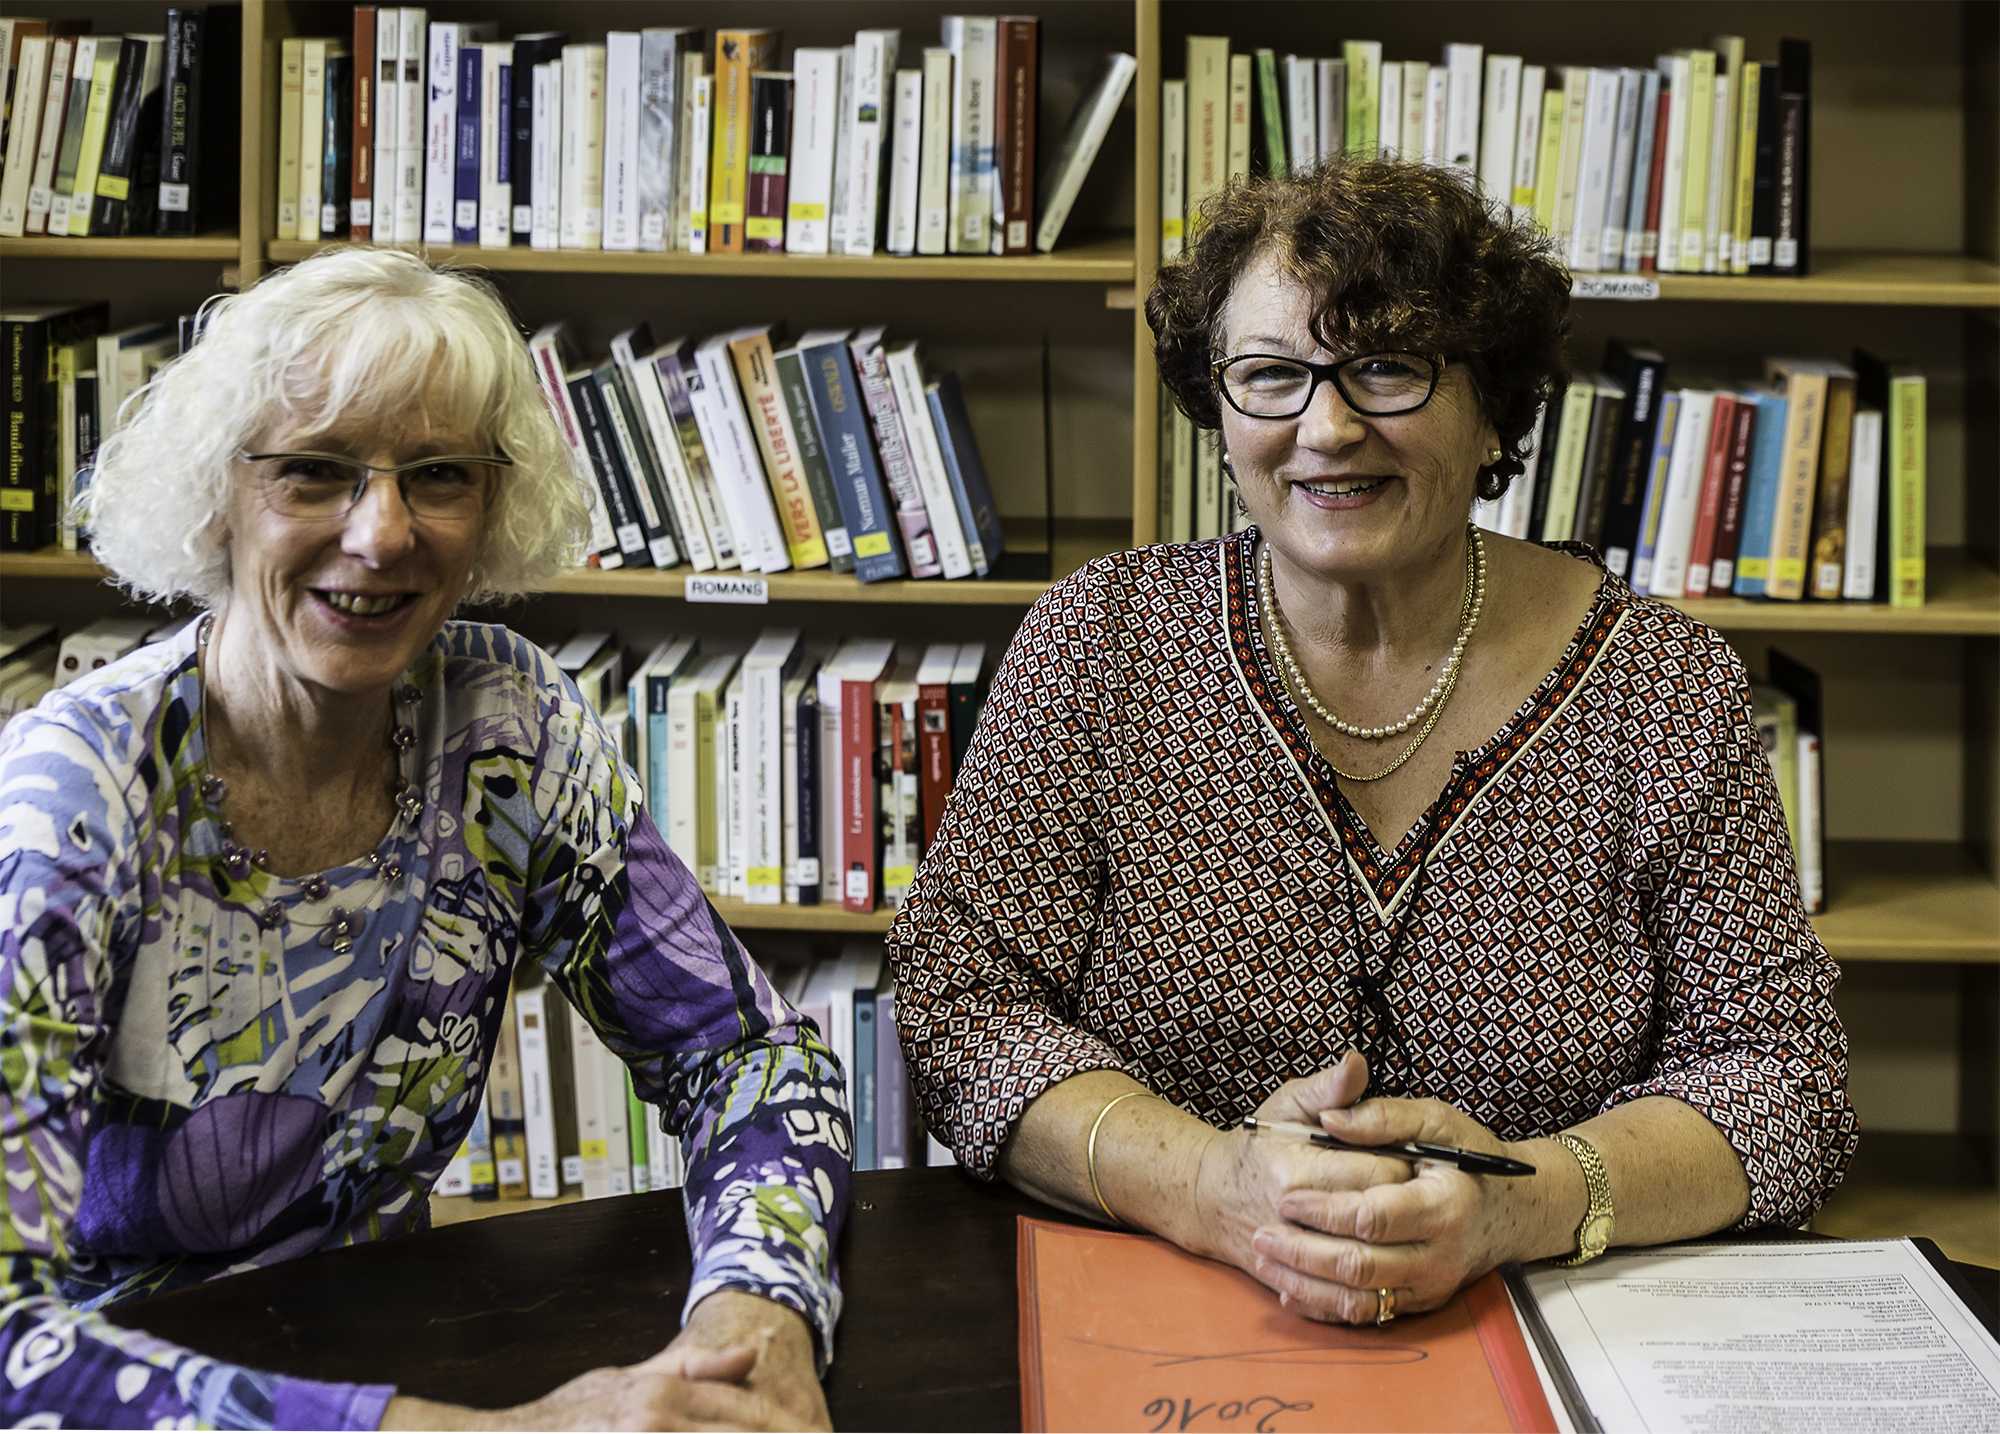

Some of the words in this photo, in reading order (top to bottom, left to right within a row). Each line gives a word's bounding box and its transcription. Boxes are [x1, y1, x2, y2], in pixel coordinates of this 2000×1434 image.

[1580, 281, 1652, 297] ROMANS
[822, 357, 846, 413] OSWALD
[8, 410, 24, 484] Baudolino
[756, 391, 792, 464] LIBERTÉ
[839, 431, 862, 475] Mailer
[783, 467, 800, 493] LA
[788, 497, 813, 543] VERS
[851, 476, 877, 531] Norman
[691, 580, 764, 597] ROMANS
[1143, 1396, 1314, 1433] 2016
